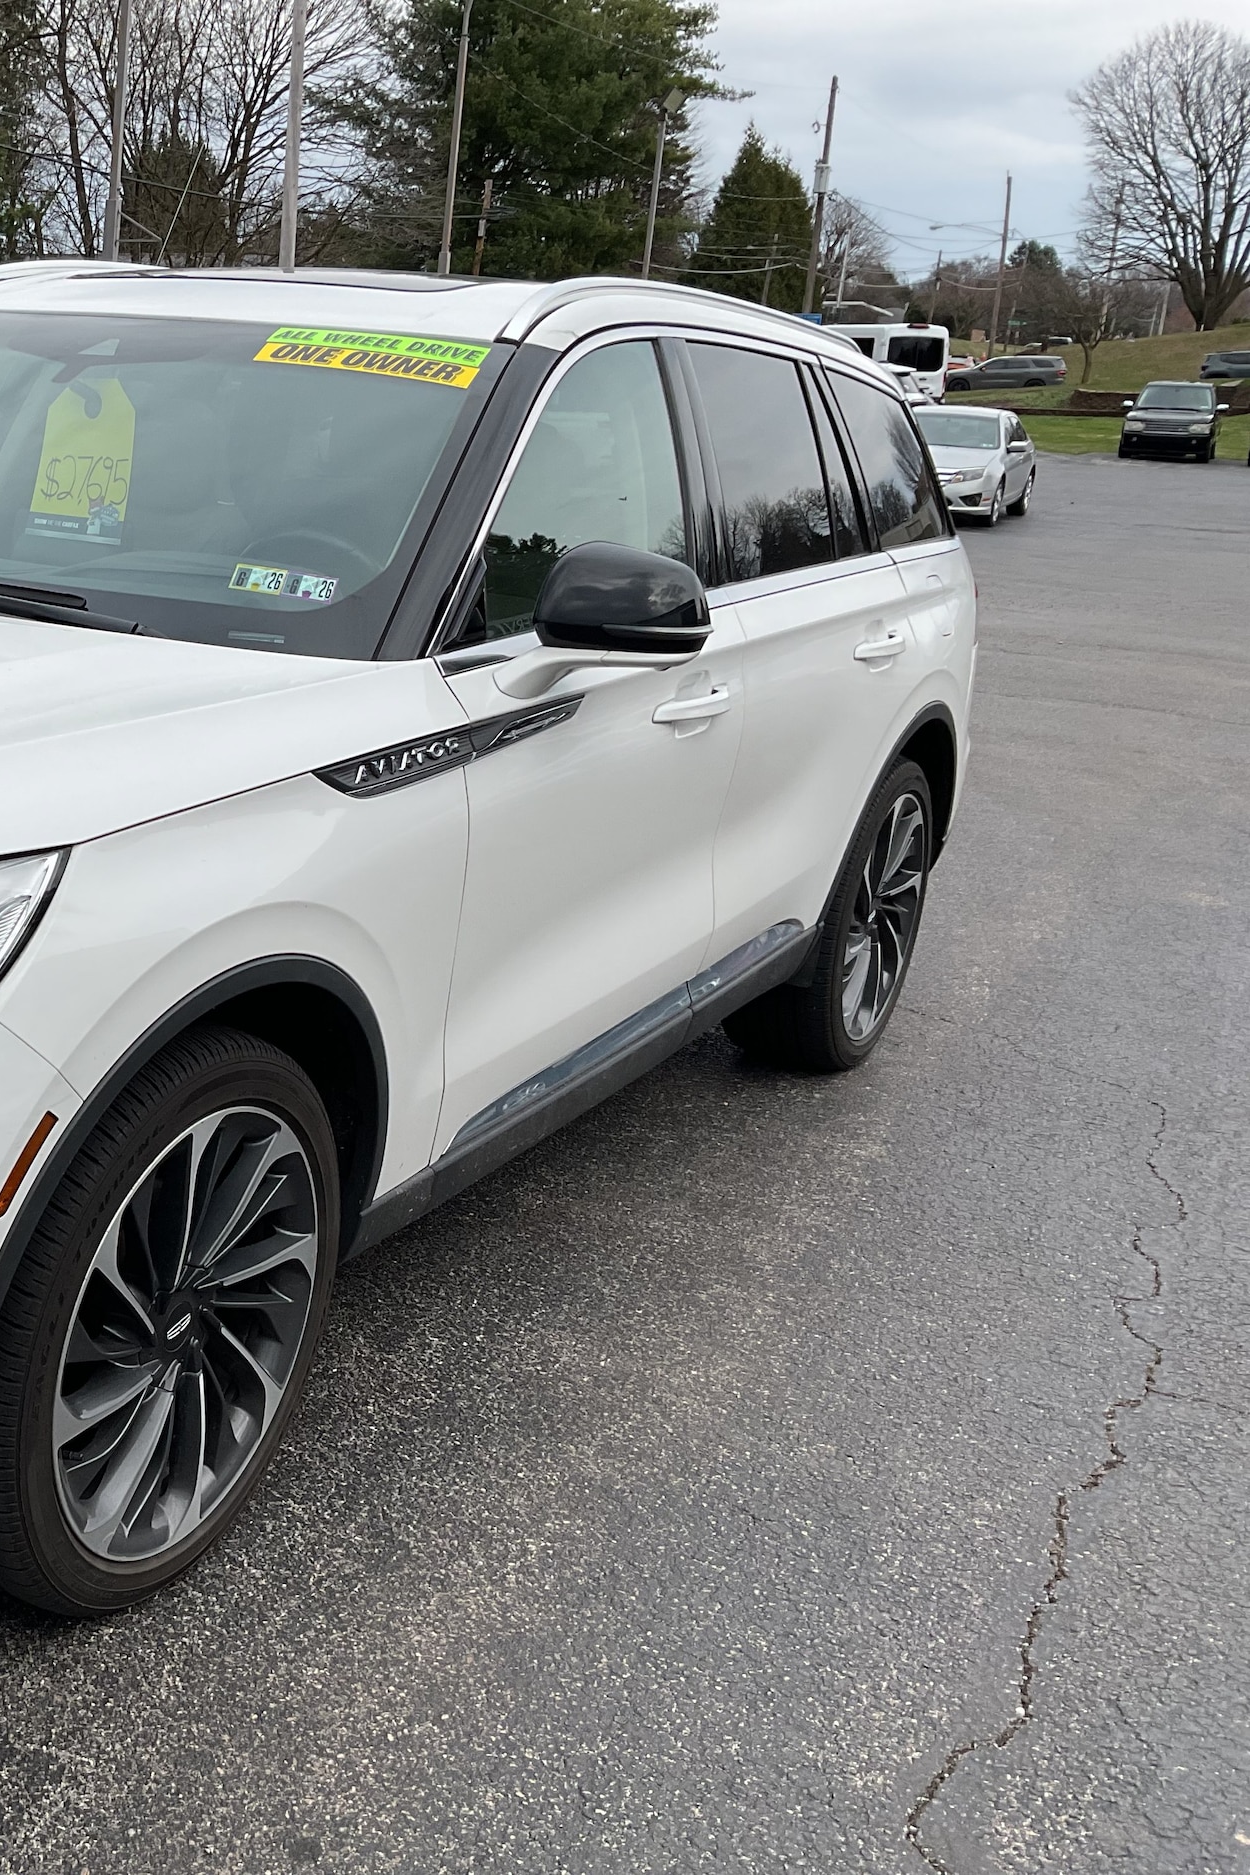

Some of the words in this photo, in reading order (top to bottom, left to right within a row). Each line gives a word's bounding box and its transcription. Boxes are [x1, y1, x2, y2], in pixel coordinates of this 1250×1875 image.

[269, 343, 344, 364] ONE
[340, 351, 465, 383] OWNER
[274, 330, 316, 342] ALL
[322, 333, 401, 351] WHEEL
[404, 341, 485, 363] DRIVE
[40, 454, 130, 505] $27,695
[236, 571, 247, 587] 6
[267, 572, 284, 590] 26
[289, 578, 300, 594] 6
[318, 580, 334, 599] 26
[354, 737, 461, 785] AVIATOR
